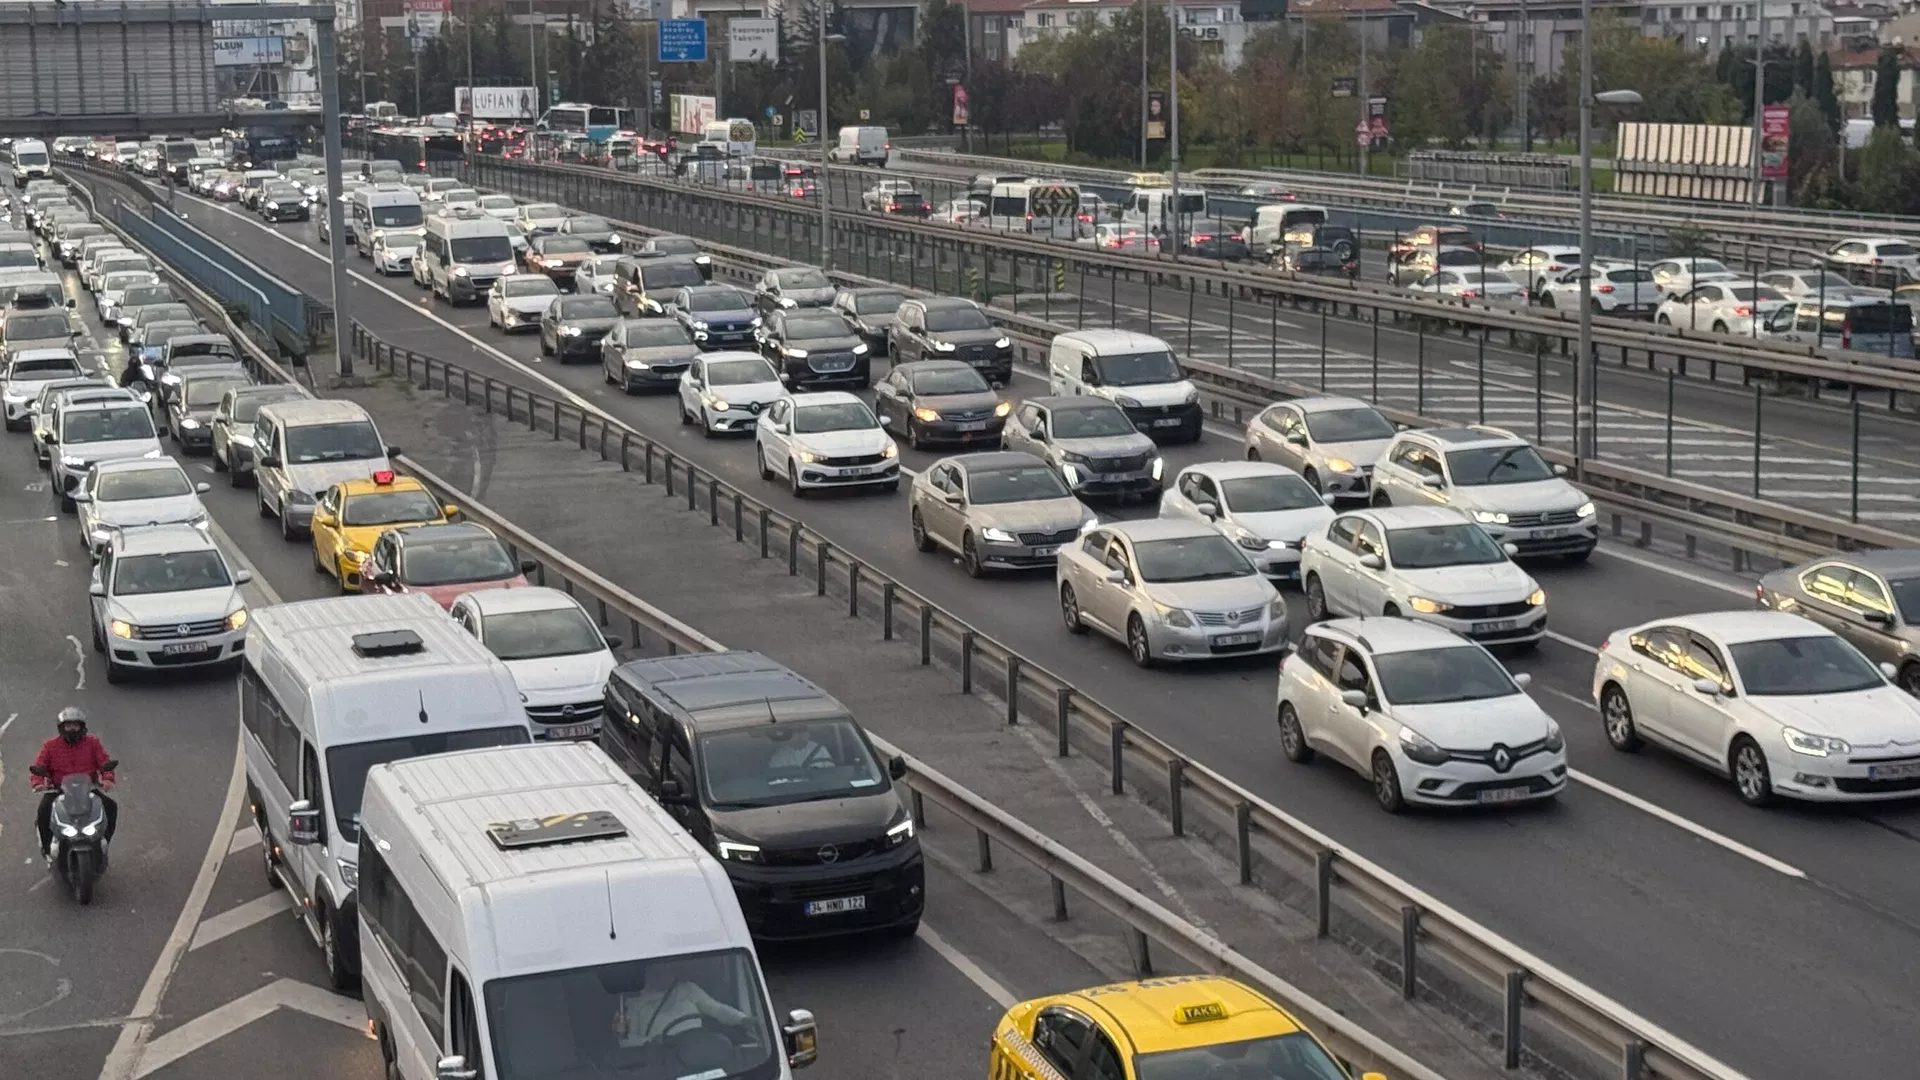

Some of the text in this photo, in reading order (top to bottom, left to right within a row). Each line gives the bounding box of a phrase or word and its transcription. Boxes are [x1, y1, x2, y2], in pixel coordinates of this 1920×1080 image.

[474, 93, 515, 109] LUFIAN
[811, 902, 822, 914] 34
[848, 896, 864, 909] 122
